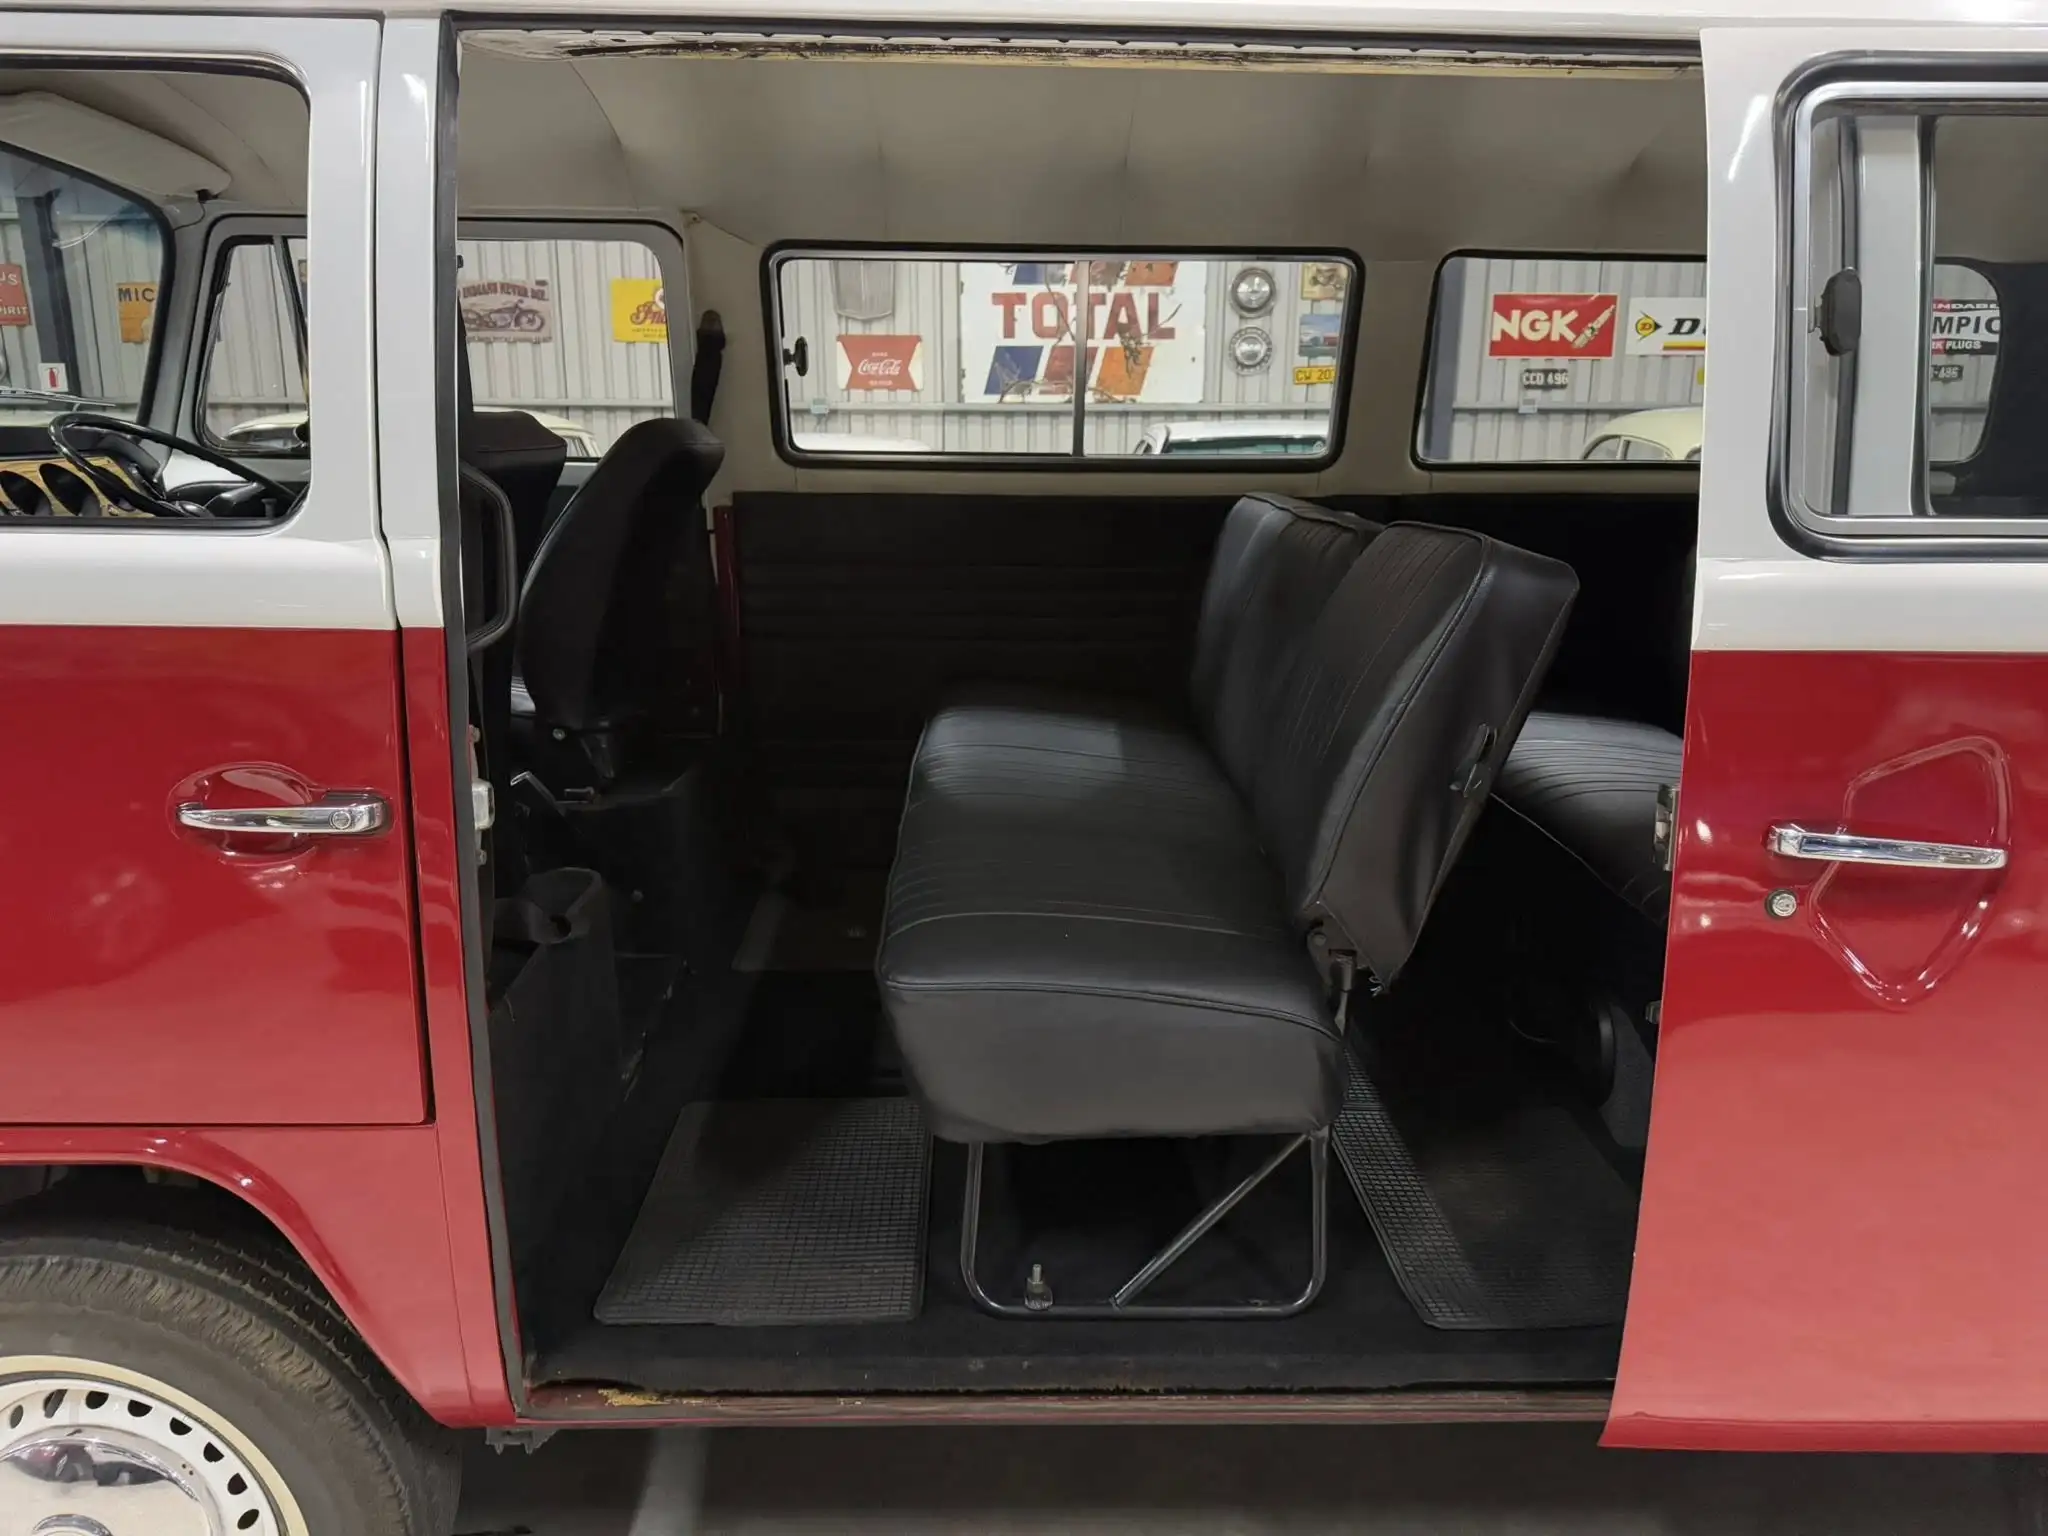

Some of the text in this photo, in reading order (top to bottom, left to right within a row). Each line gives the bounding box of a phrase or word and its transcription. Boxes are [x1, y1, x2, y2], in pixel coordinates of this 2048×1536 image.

[118, 287, 155, 302] MIC
[0, 305, 28, 315] IRIT
[992, 291, 1175, 340] TOTAL
[1492, 309, 1579, 343] NGK
[1945, 341, 1982, 350] PLUGS
